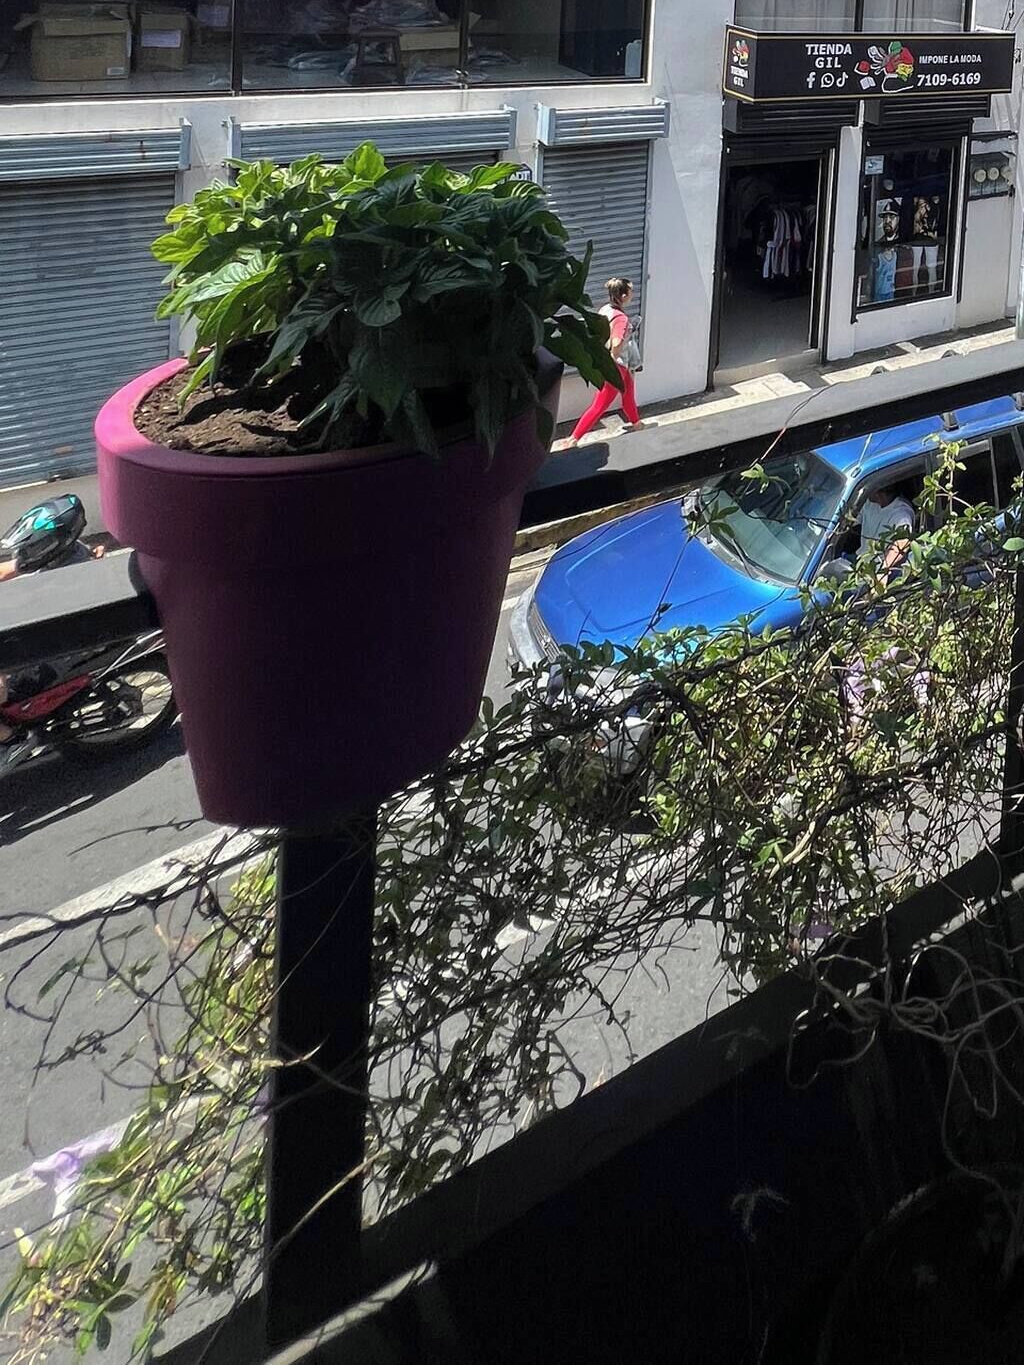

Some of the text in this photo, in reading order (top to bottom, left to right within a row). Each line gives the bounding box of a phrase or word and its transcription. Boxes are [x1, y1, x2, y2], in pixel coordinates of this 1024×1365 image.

[805, 43, 852, 55] TIENDA
[815, 56, 842, 69] GIL
[919, 54, 982, 64] IMPONE LA MODA
[917, 72, 981, 87] 7109-6169
